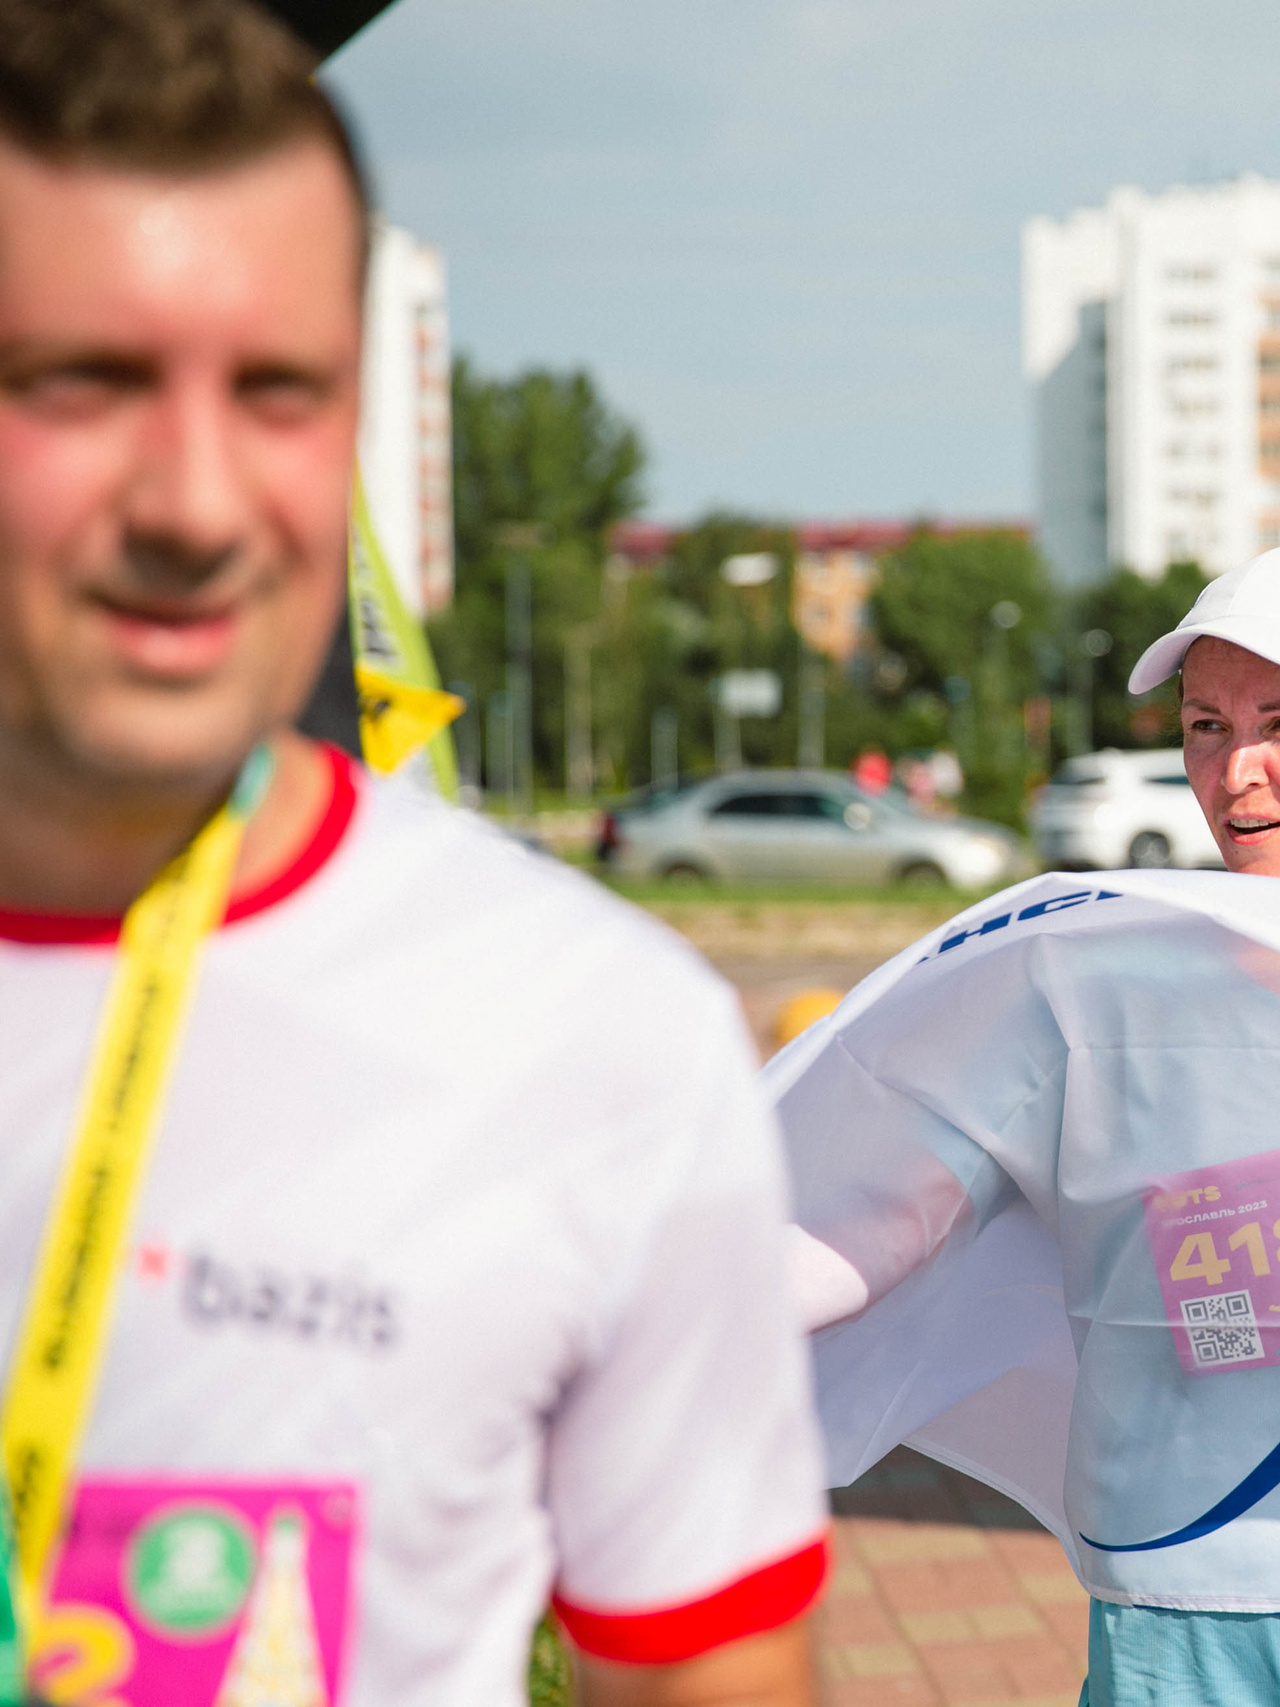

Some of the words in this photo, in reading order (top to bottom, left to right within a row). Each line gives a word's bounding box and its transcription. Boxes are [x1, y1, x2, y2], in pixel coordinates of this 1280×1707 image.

[1152, 1185, 1222, 1213] TS
[1237, 1199, 1269, 1215] 2023
[181, 1246, 404, 1354] bazis
